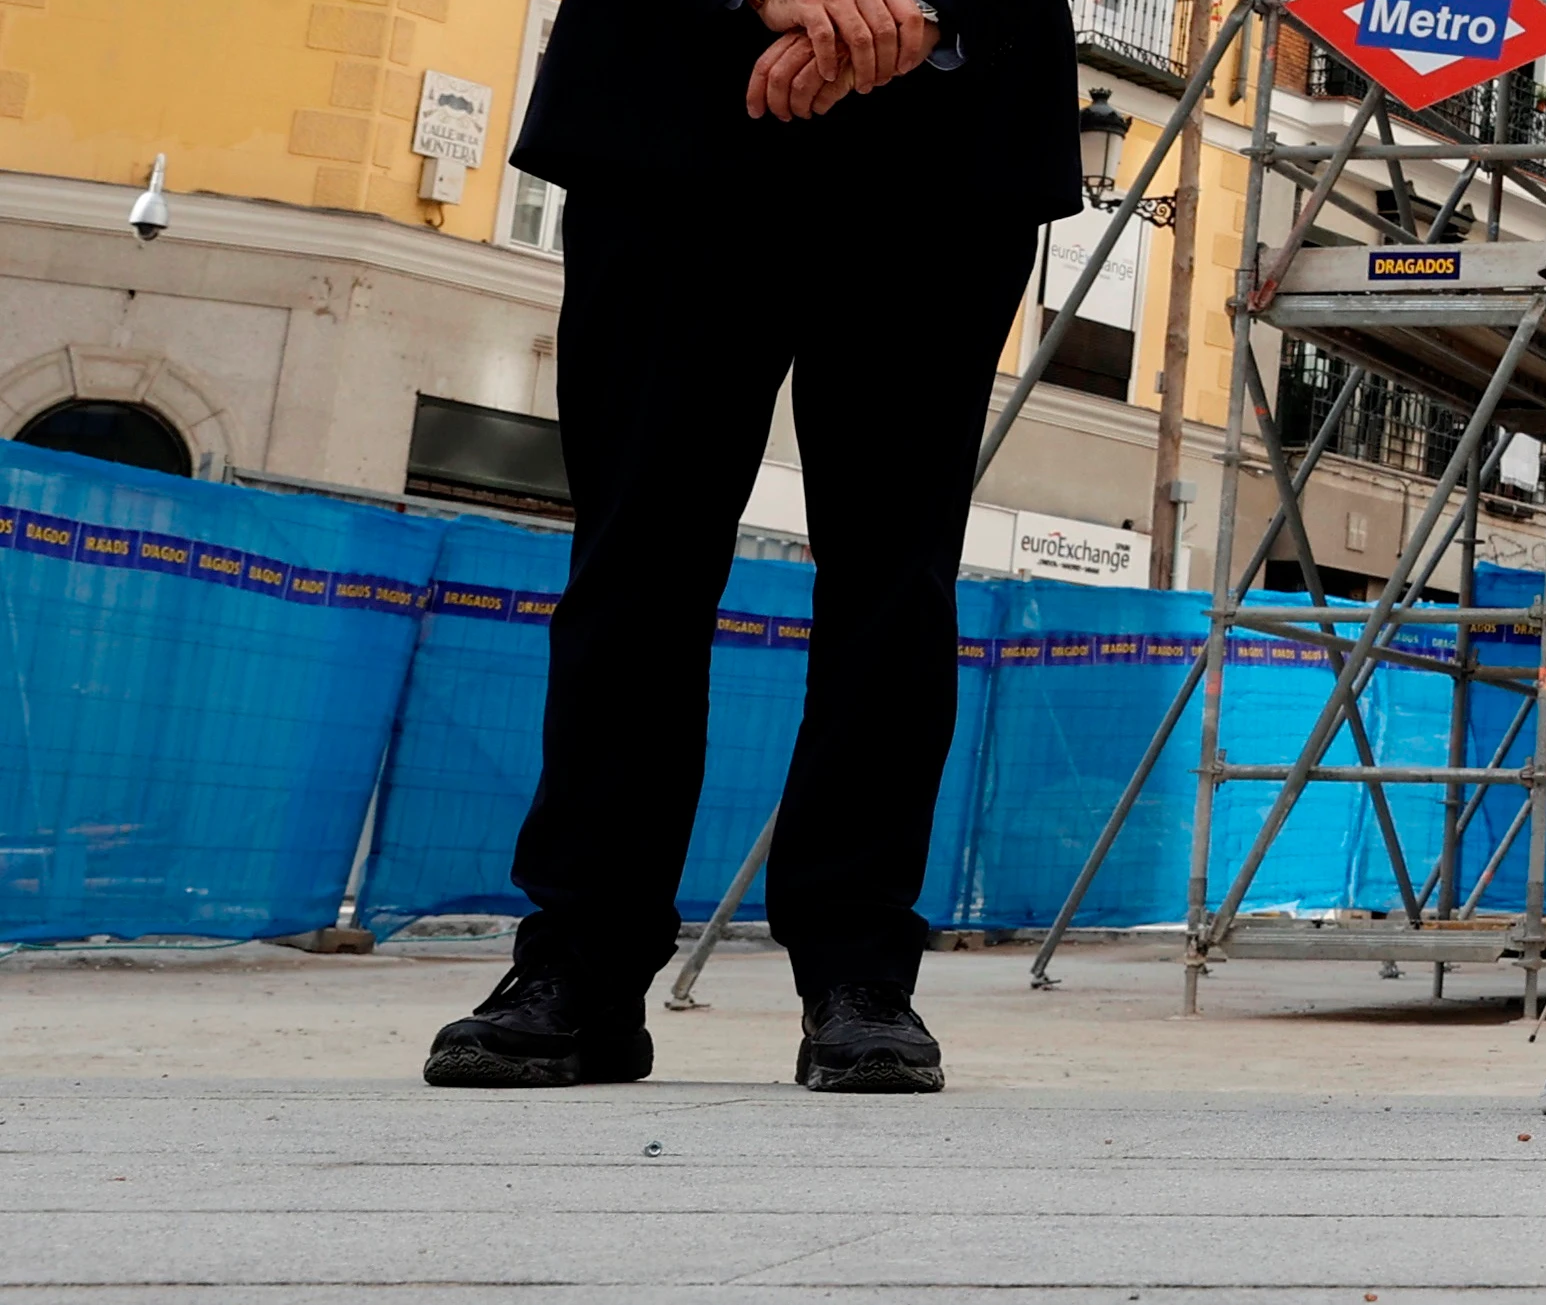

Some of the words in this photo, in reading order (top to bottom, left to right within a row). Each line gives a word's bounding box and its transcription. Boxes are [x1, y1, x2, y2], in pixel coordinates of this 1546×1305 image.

[420, 137, 478, 163] MONTERA
[1374, 258, 1455, 274] DRAGADOS
[1021, 534, 1131, 573] euroExchange
